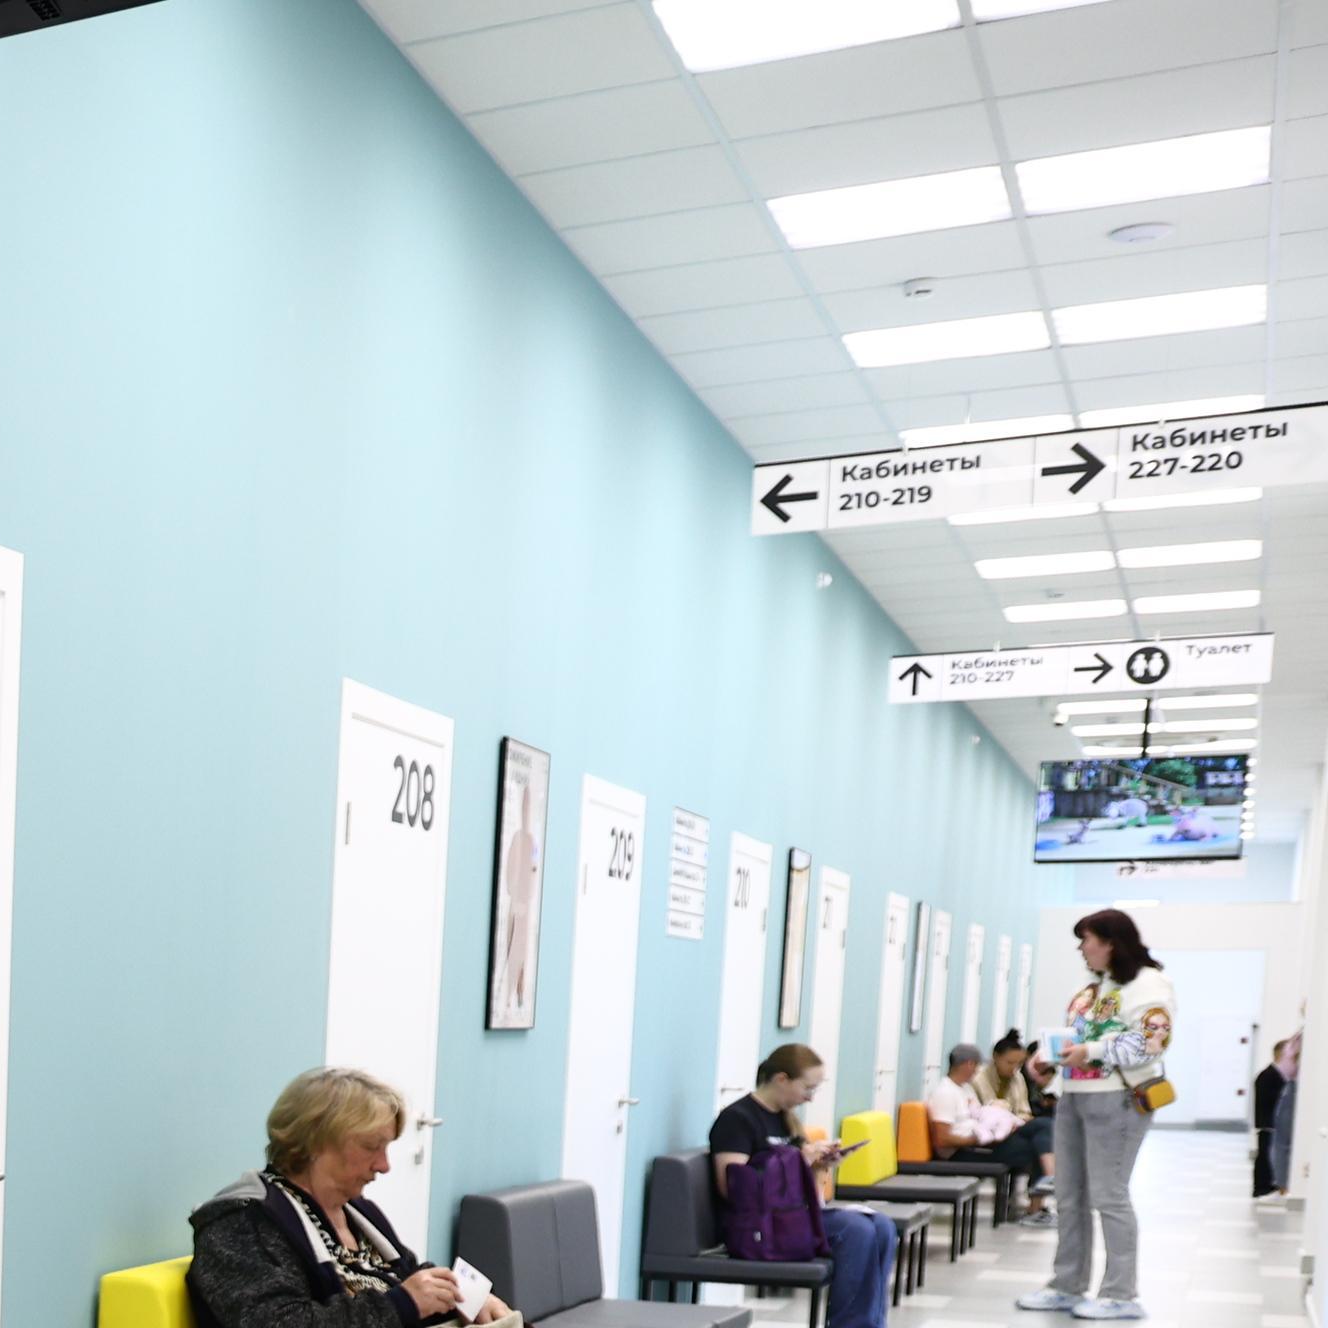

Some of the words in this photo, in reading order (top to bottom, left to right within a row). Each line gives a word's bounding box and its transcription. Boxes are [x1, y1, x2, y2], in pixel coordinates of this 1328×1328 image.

[1131, 421, 1289, 453] Кабинеты
[841, 454, 982, 483] Кабинеты
[1128, 450, 1244, 480] 227-220
[839, 485, 933, 512] 210-219
[950, 656, 1044, 670] Кабинеты
[1185, 643, 1253, 659] Туалет
[949, 670, 1015, 685] 210-227
[391, 754, 435, 832] 208
[608, 825, 635, 882] 209
